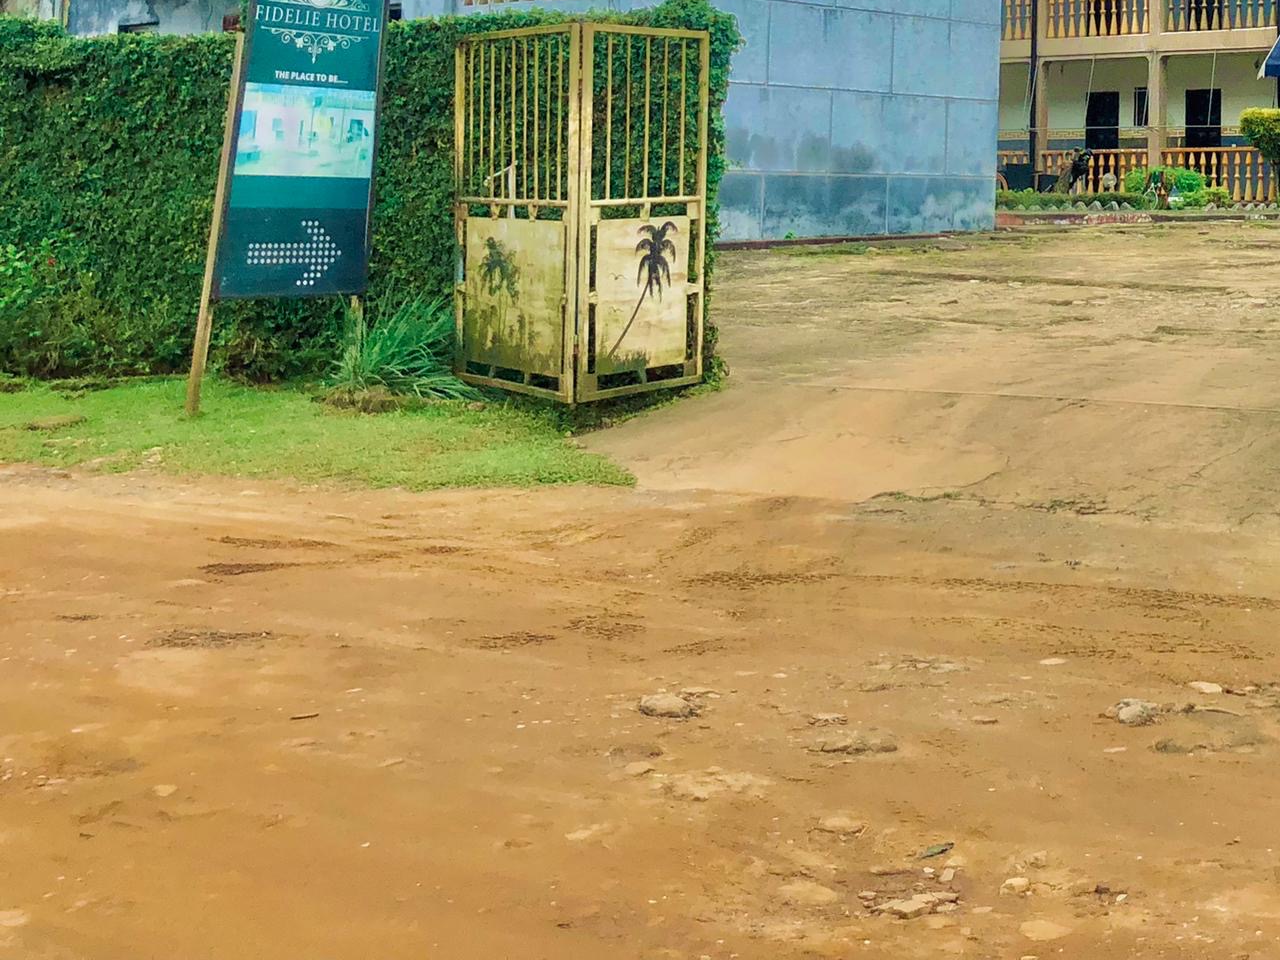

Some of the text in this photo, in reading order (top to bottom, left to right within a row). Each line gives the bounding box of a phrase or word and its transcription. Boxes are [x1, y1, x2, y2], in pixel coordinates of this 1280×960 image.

[255, 4, 380, 32] FIDELIE HOTEL
[275, 70, 290, 79] THE
[291, 71, 315, 81] PLACE
[316, 73, 327, 82] TO
